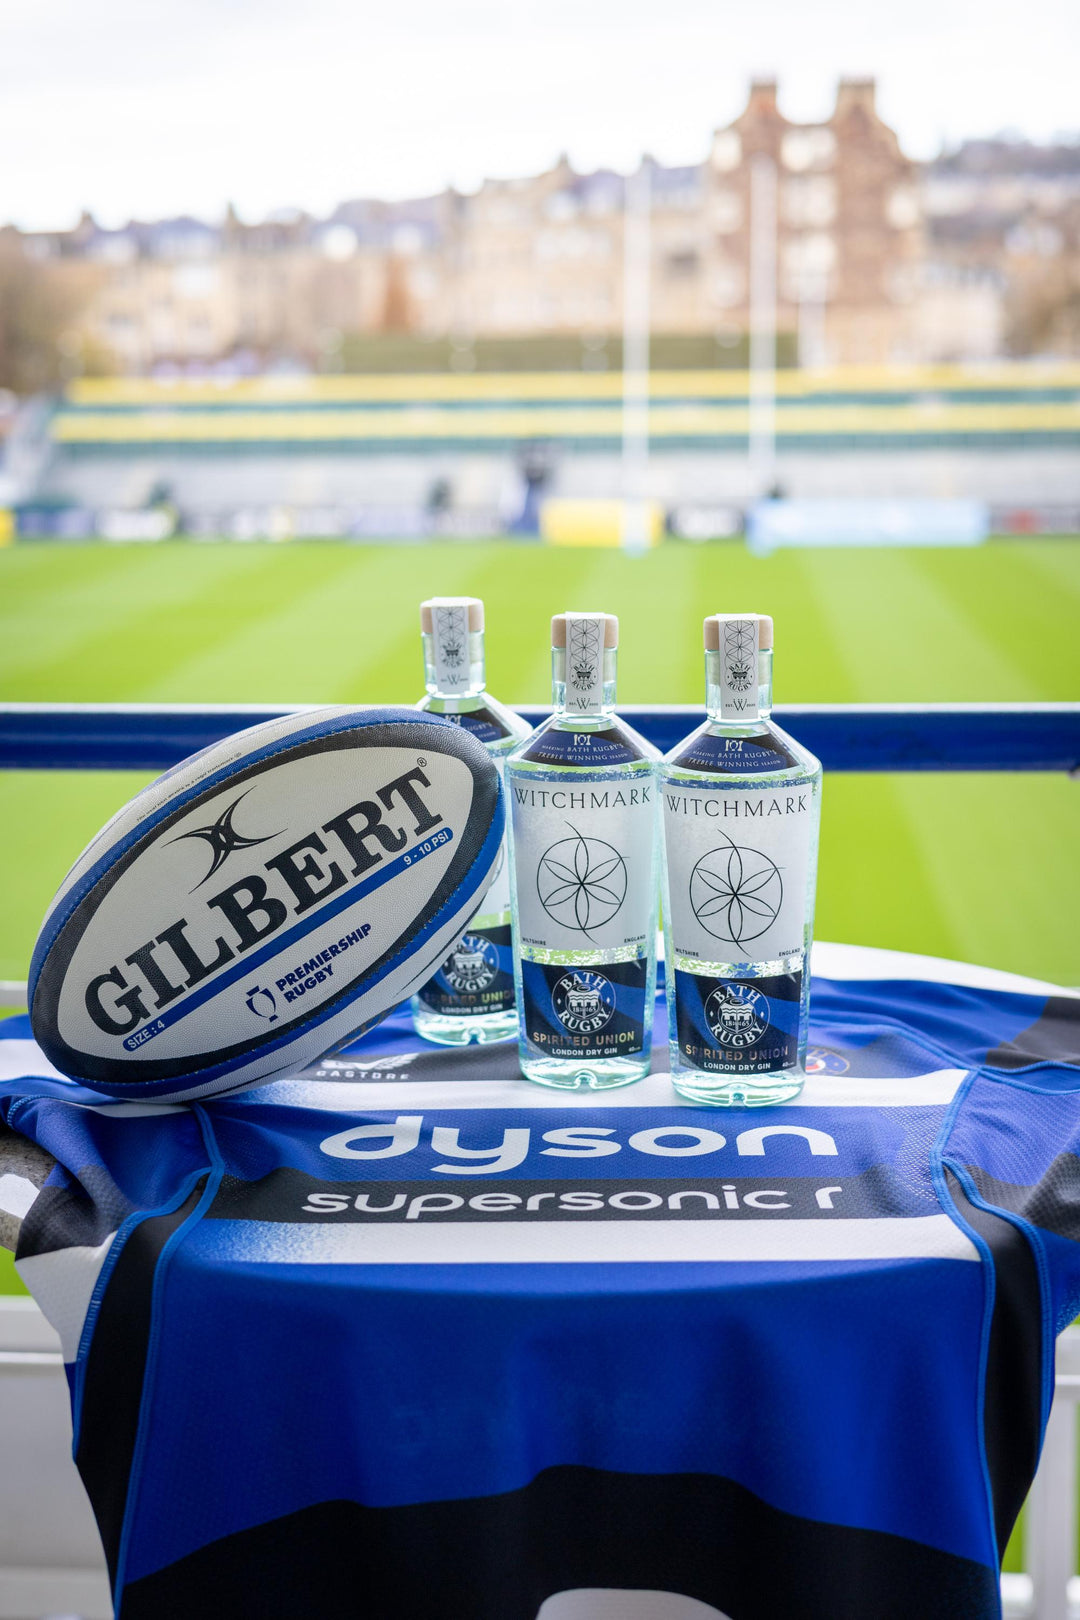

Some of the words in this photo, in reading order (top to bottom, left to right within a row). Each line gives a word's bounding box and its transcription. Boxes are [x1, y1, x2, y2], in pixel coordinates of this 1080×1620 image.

[573, 663, 595, 672] BATH
[728, 663, 751, 672] BATH
[572, 680, 596, 691] RUGBY
[727, 681, 752, 692] RUGBY
[592, 743, 624, 752] RUGBY'S
[744, 749, 777, 758] RUGBY'S
[537, 752, 564, 760] TREBLE
[688, 758, 714, 766] TREBLE
[717, 760, 760, 768] WINNING
[514, 785, 651, 809] WITCHMARK
[666, 794, 807, 818] WITCHMARK
[403, 853, 412, 866] 9
[418, 842, 432, 855] 10
[432, 830, 449, 847] PSI
[84, 767, 443, 1036] GILBERT
[522, 937, 546, 946] WILTSHIRE
[624, 934, 646, 944] ENGLAND
[275, 923, 372, 991] PREMIERSHIP
[675, 948, 699, 957] WILTSHIRE
[284, 963, 335, 1004] RUGBY
[446, 969, 494, 991] RUGBY
[559, 971, 607, 991] BATH
[712, 984, 761, 1003] BATH
[558, 1008, 609, 1032] RUGBY
[127, 1028, 152, 1049] SIZE
[157, 1020, 165, 1030] 4
[533, 1031, 590, 1046] SPIRITED
[596, 1030, 635, 1045] UNION
[710, 1023, 765, 1046] RUGBY
[551, 1047, 583, 1056] LONDON
[604, 1047, 618, 1055] GIN
[749, 1045, 789, 1061] UNION
[316, 1069, 410, 1080] CASTORE
[703, 1062, 736, 1070] LONDON
[738, 1062, 756, 1071] DRY
[757, 1062, 771, 1070] GIN
[319, 1115, 839, 1175] dyson
[301, 1184, 792, 1220] supersonic
[815, 1186, 843, 1210] r
